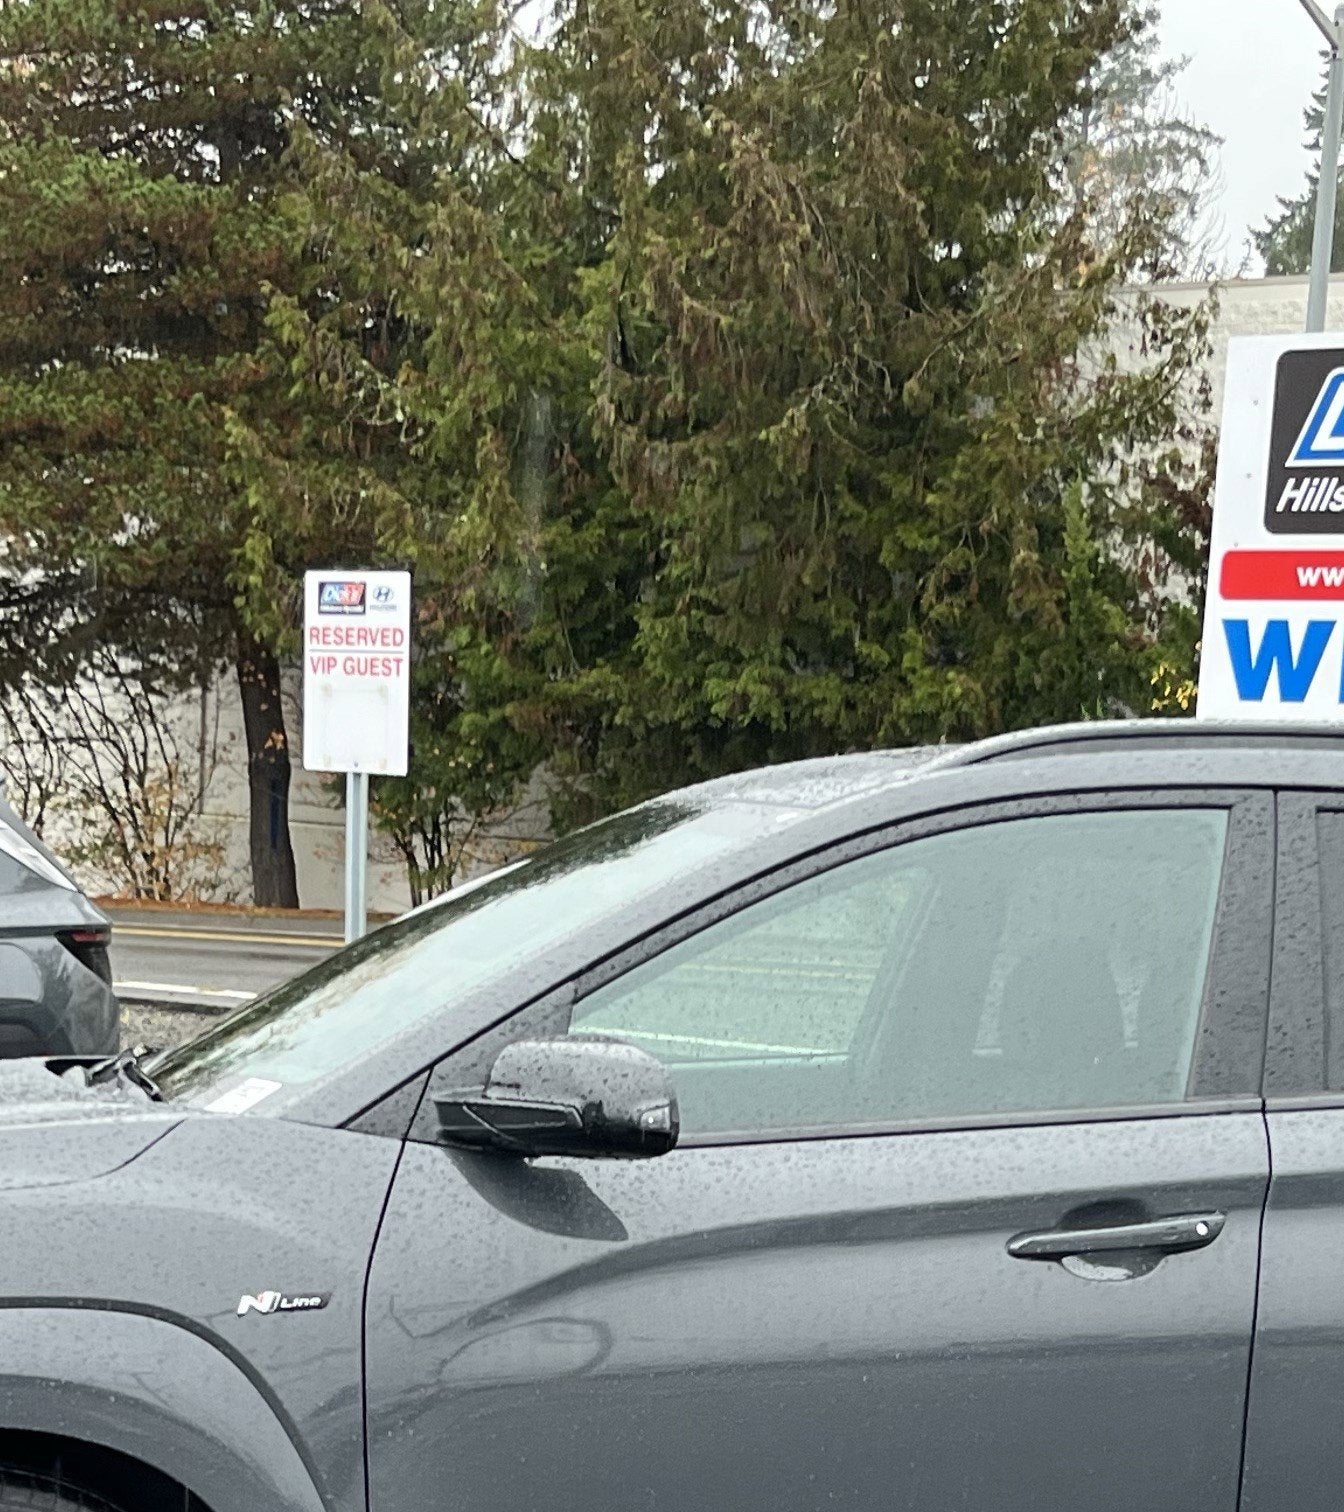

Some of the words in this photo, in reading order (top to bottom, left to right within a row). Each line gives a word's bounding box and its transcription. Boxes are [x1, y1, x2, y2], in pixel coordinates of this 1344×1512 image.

[309, 626, 404, 648] RESERVED
[310, 656, 338, 675] VIP
[343, 656, 403, 678] GUEST
